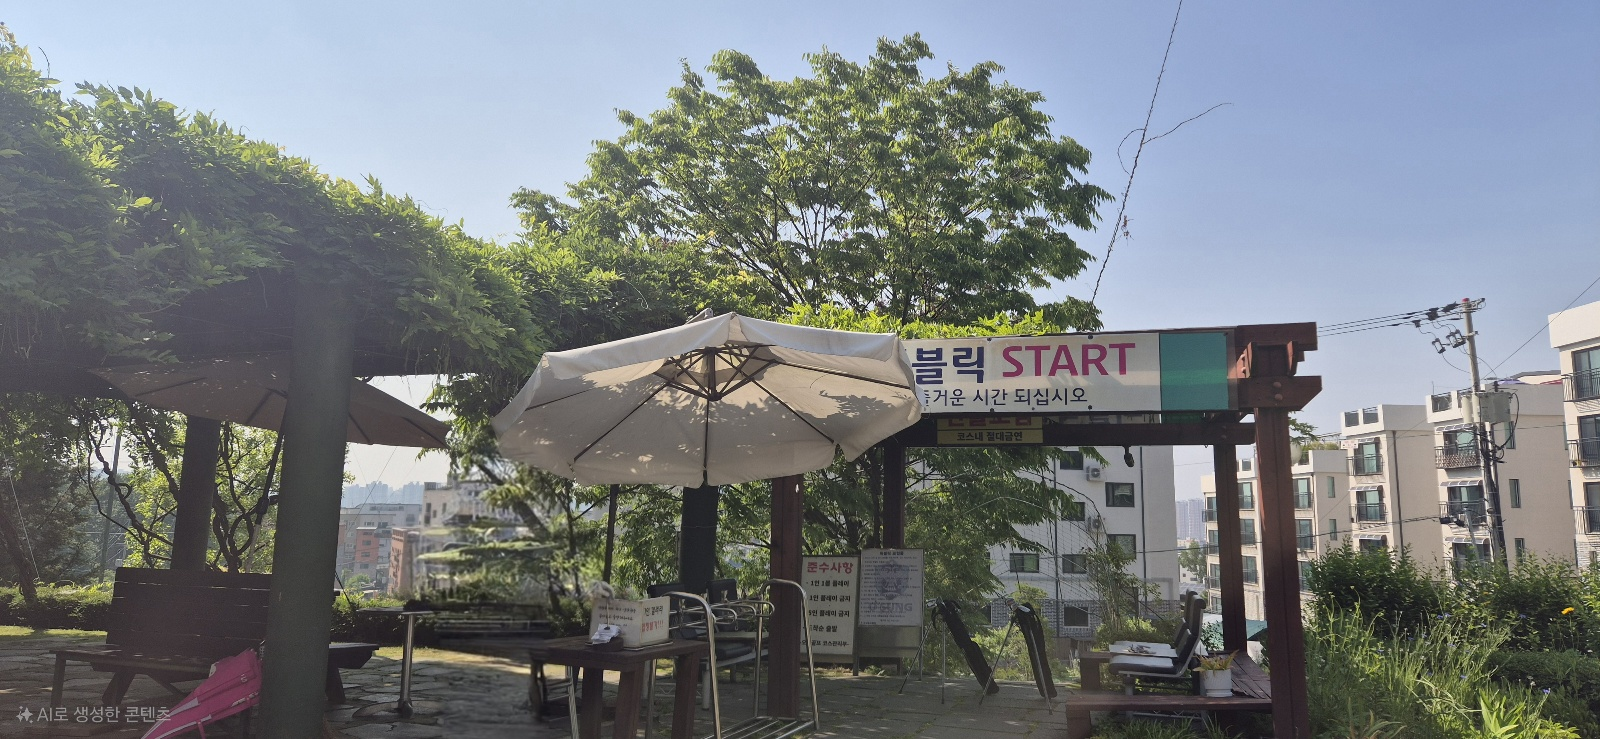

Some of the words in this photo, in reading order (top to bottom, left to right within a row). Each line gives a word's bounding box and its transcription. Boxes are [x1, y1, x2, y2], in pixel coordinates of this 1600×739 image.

[904, 347, 985, 384] 블릭
[1002, 343, 1136, 377] START
[973, 388, 1008, 406] 시간
[1015, 387, 1088, 406] 되십시오
[956, 432, 984, 442] 코스내
[986, 432, 1023, 442] 절대금연
[807, 562, 854, 574] 준수사항
